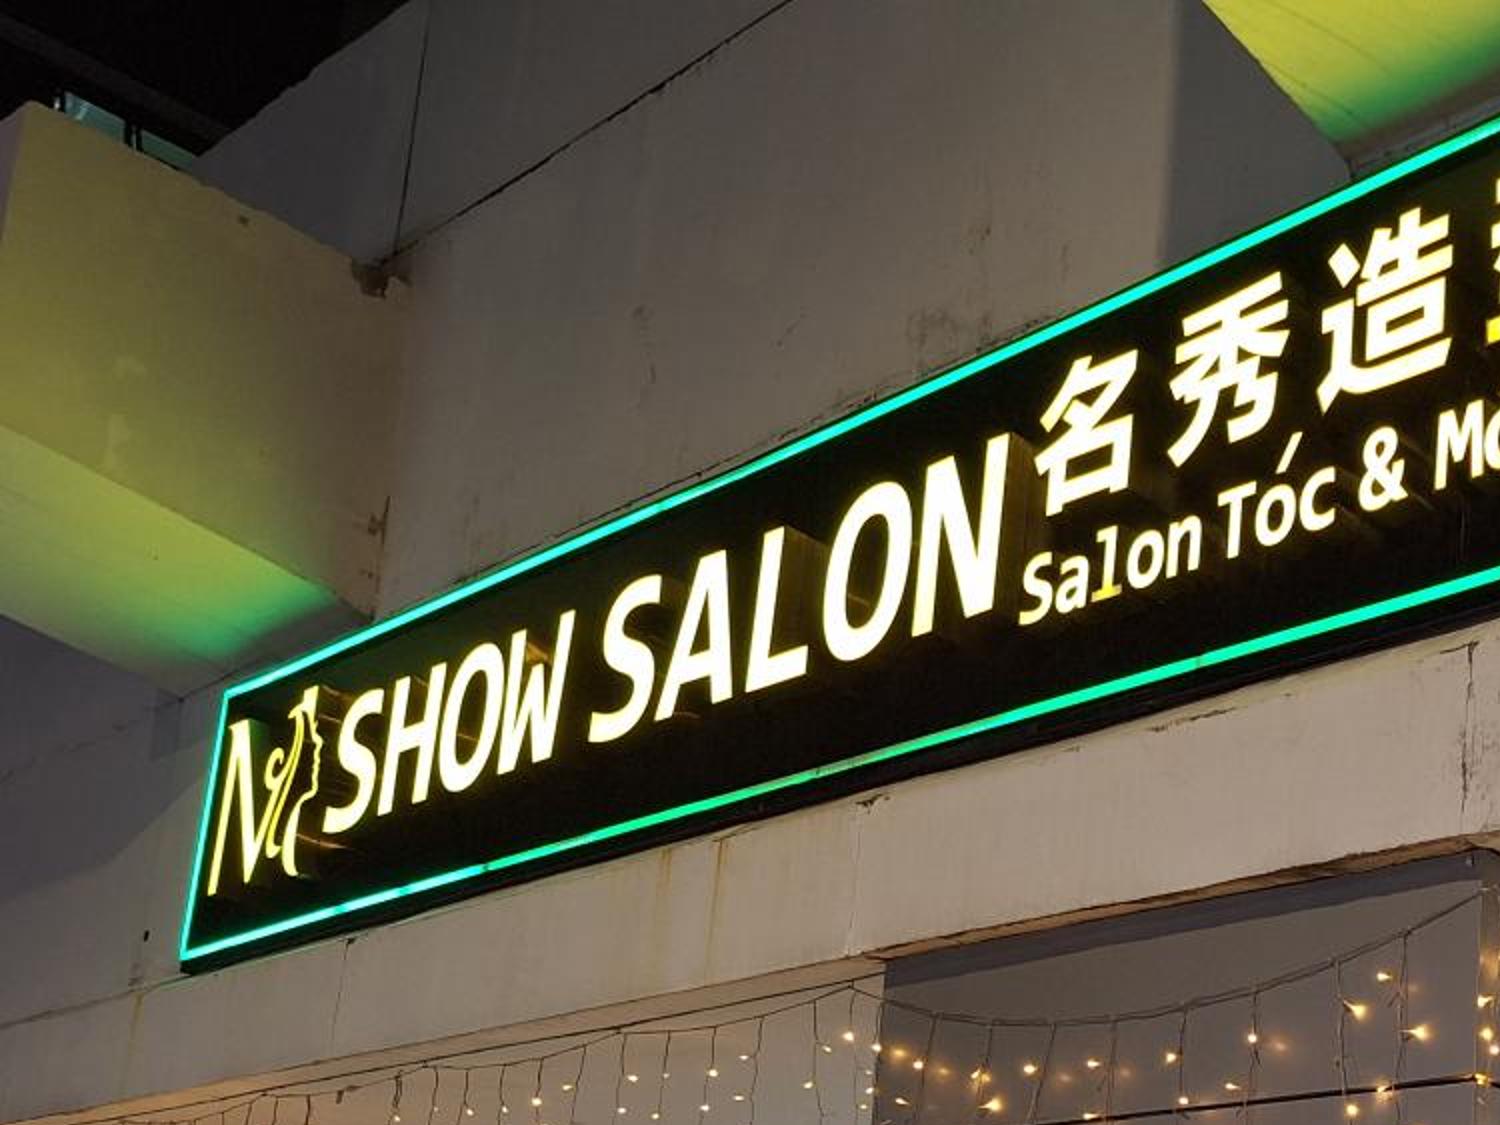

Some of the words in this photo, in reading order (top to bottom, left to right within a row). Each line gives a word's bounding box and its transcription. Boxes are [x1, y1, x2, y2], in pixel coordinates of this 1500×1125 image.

[322, 609, 576, 834] SHOW
[588, 433, 1010, 743] SALON
[1018, 525, 1202, 626] Salon
[1217, 431, 1337, 559] Tóc
[1358, 426, 1409, 512] &
